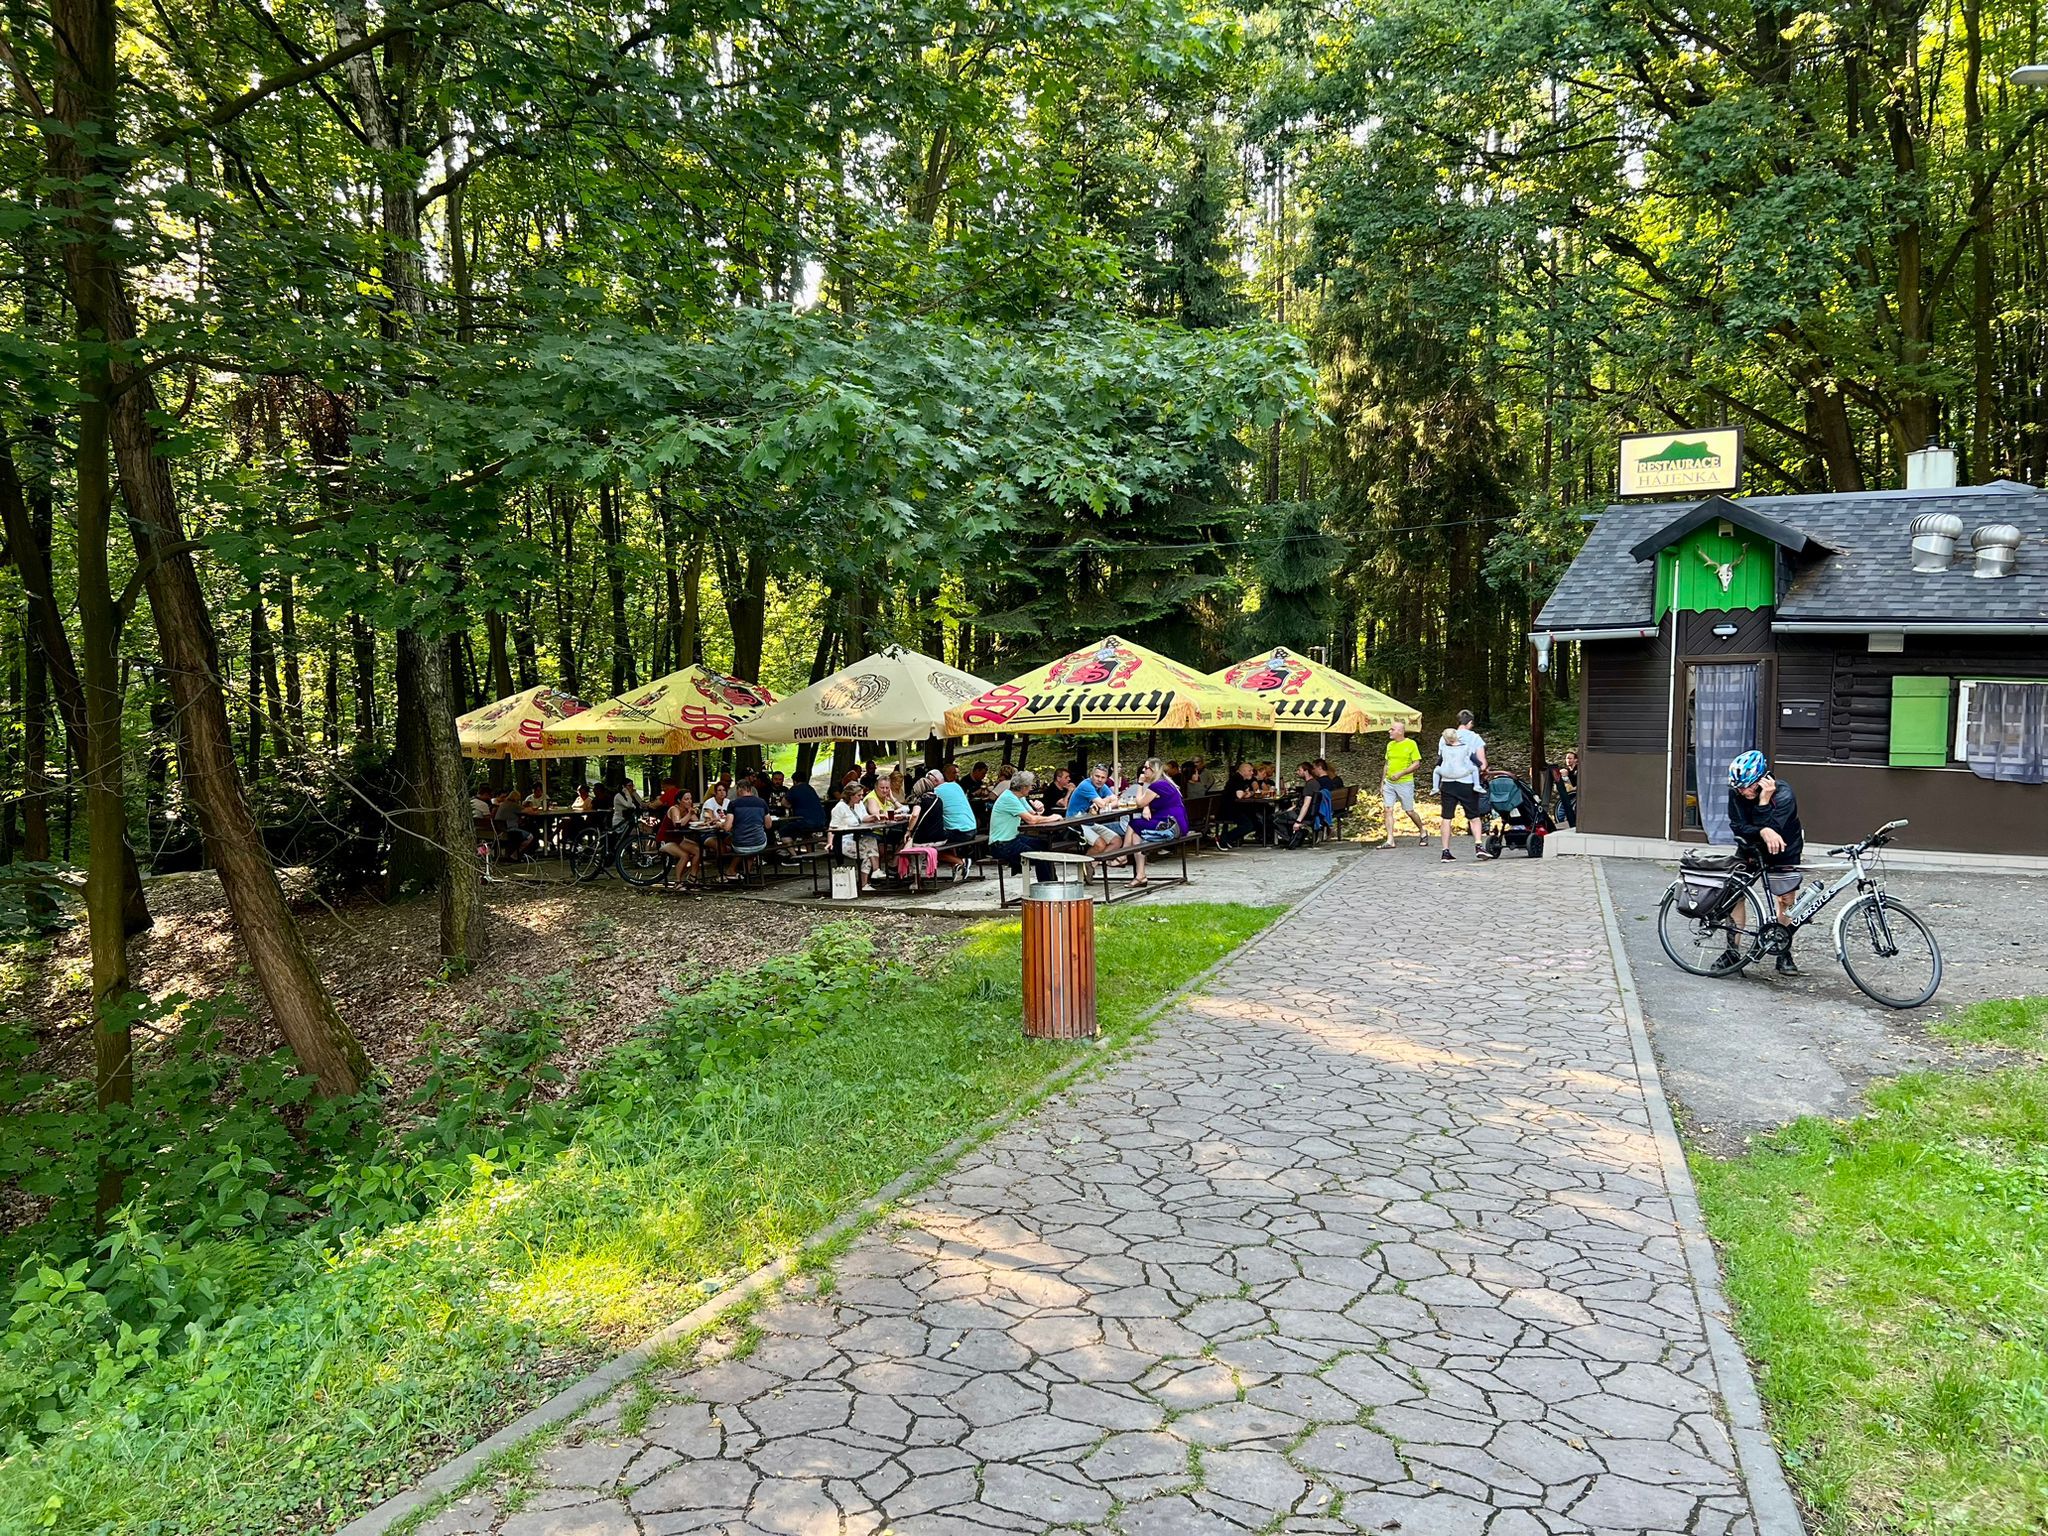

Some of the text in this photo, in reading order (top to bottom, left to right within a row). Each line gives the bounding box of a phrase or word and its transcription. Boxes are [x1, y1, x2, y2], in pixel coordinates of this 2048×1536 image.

[1638, 457, 1721, 473] RESTAURACE
[963, 684, 1176, 726] Svijany
[794, 723, 869, 739] PIVOVAR KONÍČEK
